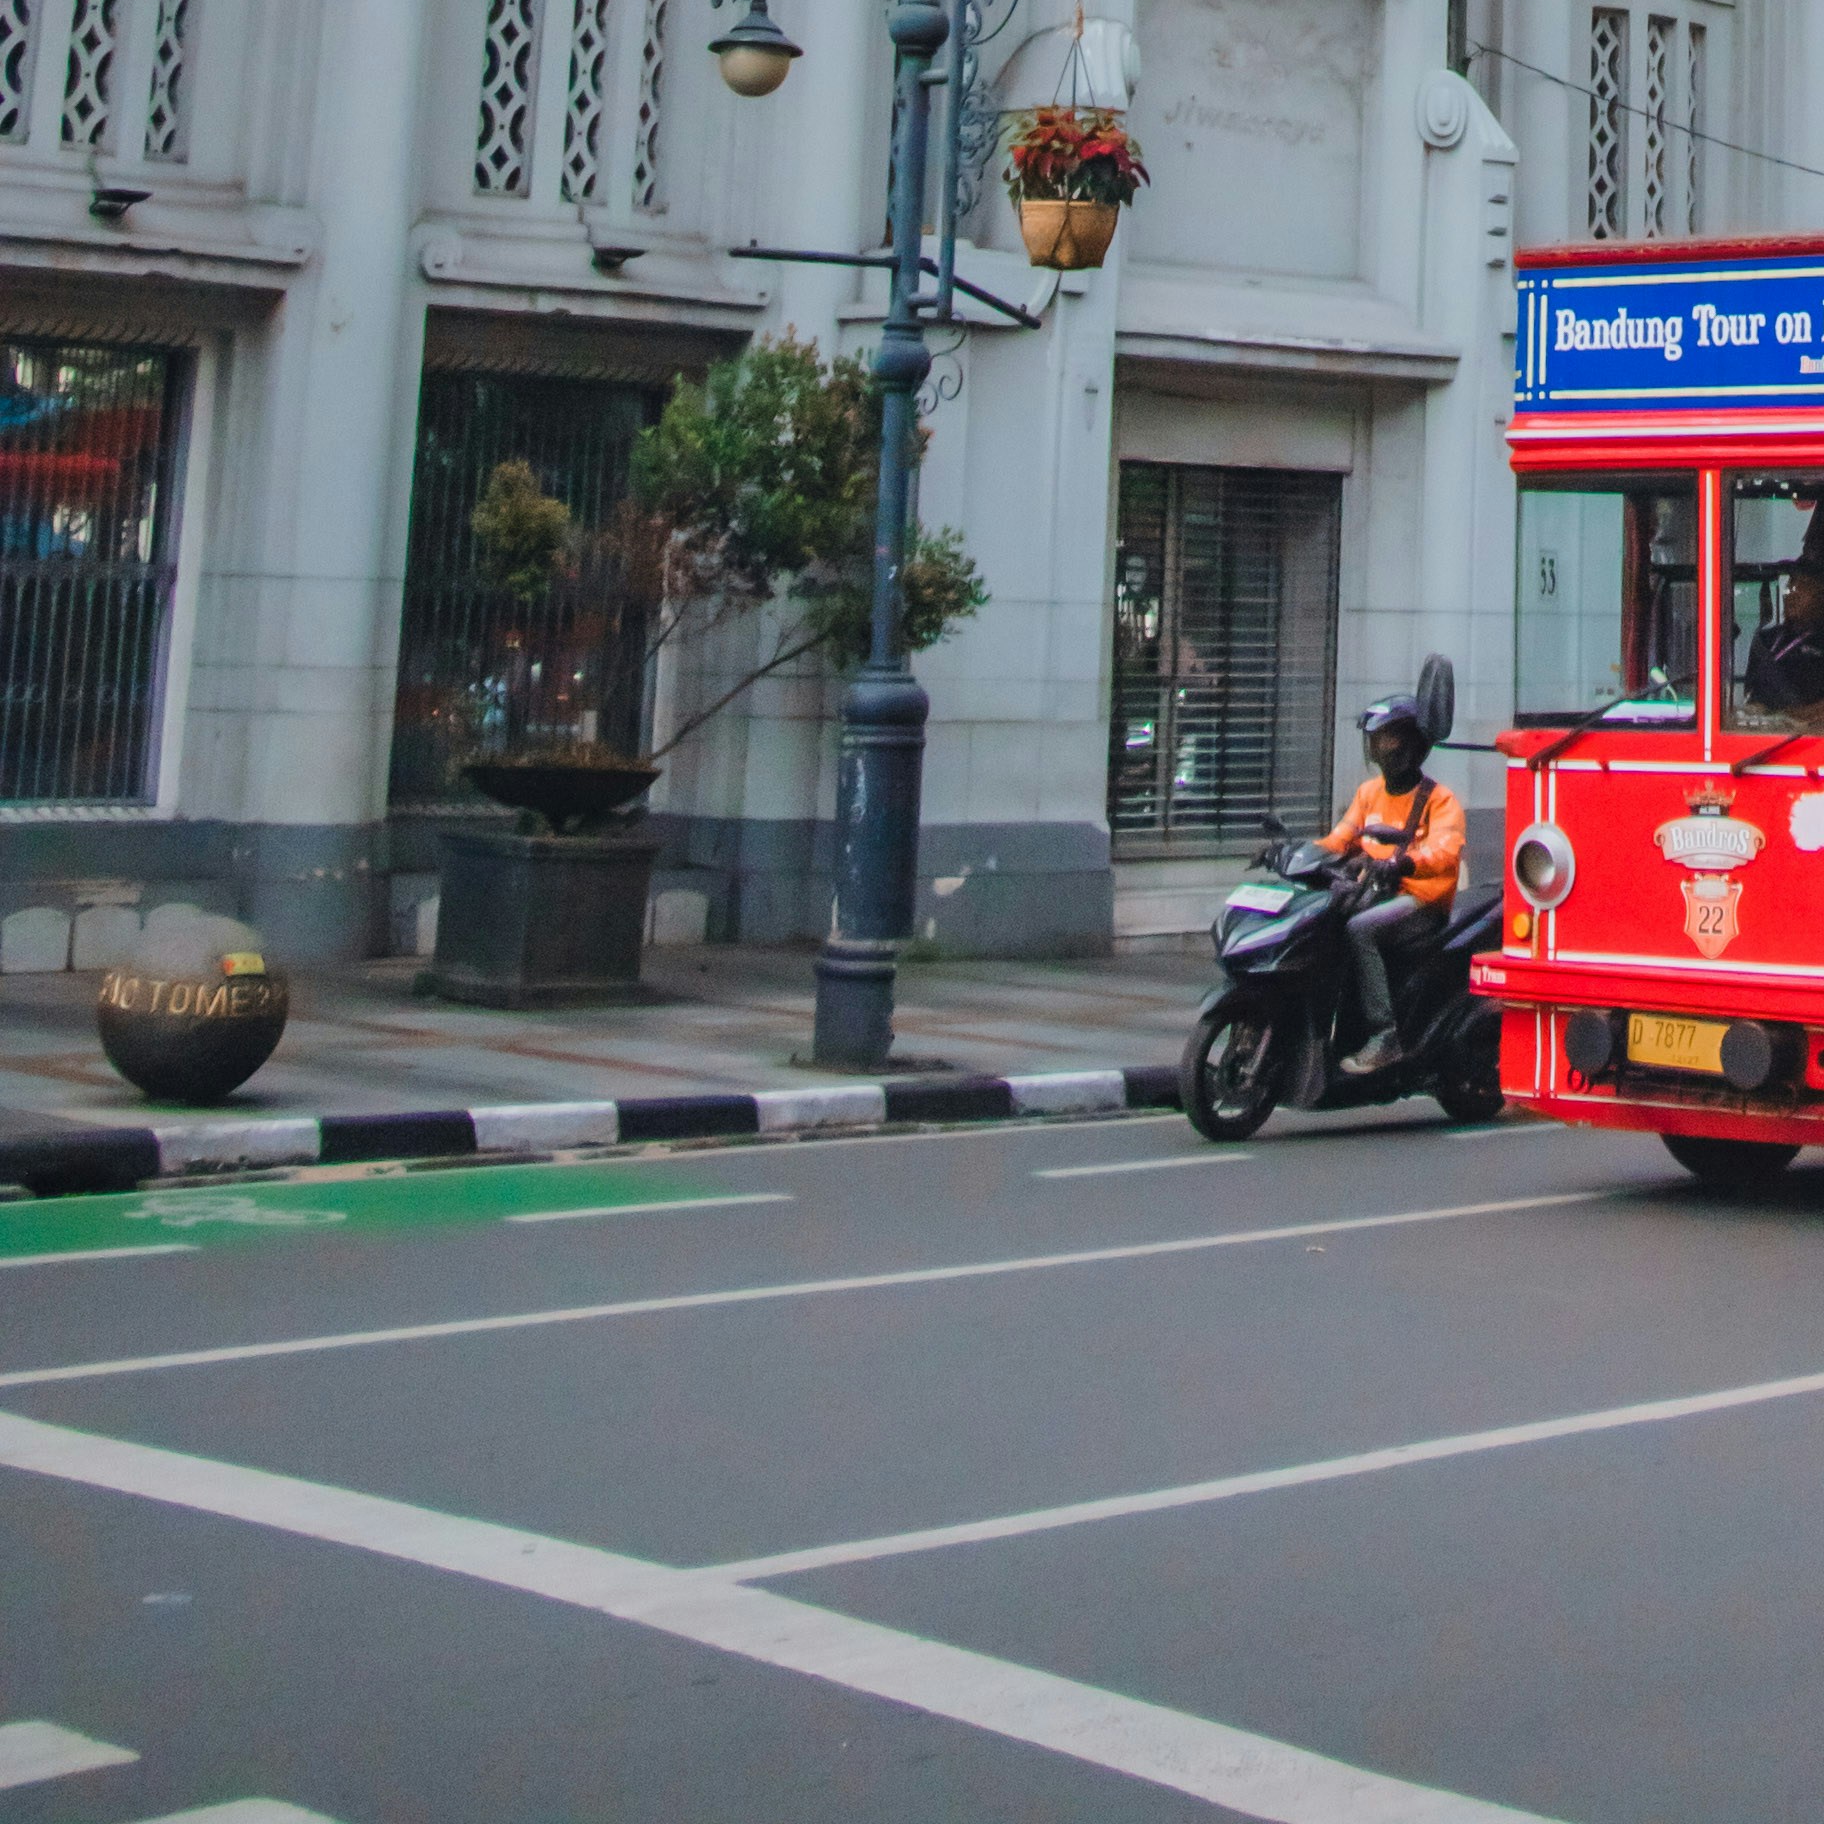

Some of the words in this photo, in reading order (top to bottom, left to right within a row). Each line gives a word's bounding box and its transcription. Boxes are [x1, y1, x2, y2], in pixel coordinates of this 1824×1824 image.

[1554, 307, 1683, 362] Bandung
[1691, 303, 1766, 347] Tour
[1775, 311, 1813, 344] on
[1698, 905, 1724, 935] 22
[1632, 1021, 1644, 1046] D
[1654, 1020, 1698, 1050] 7877
